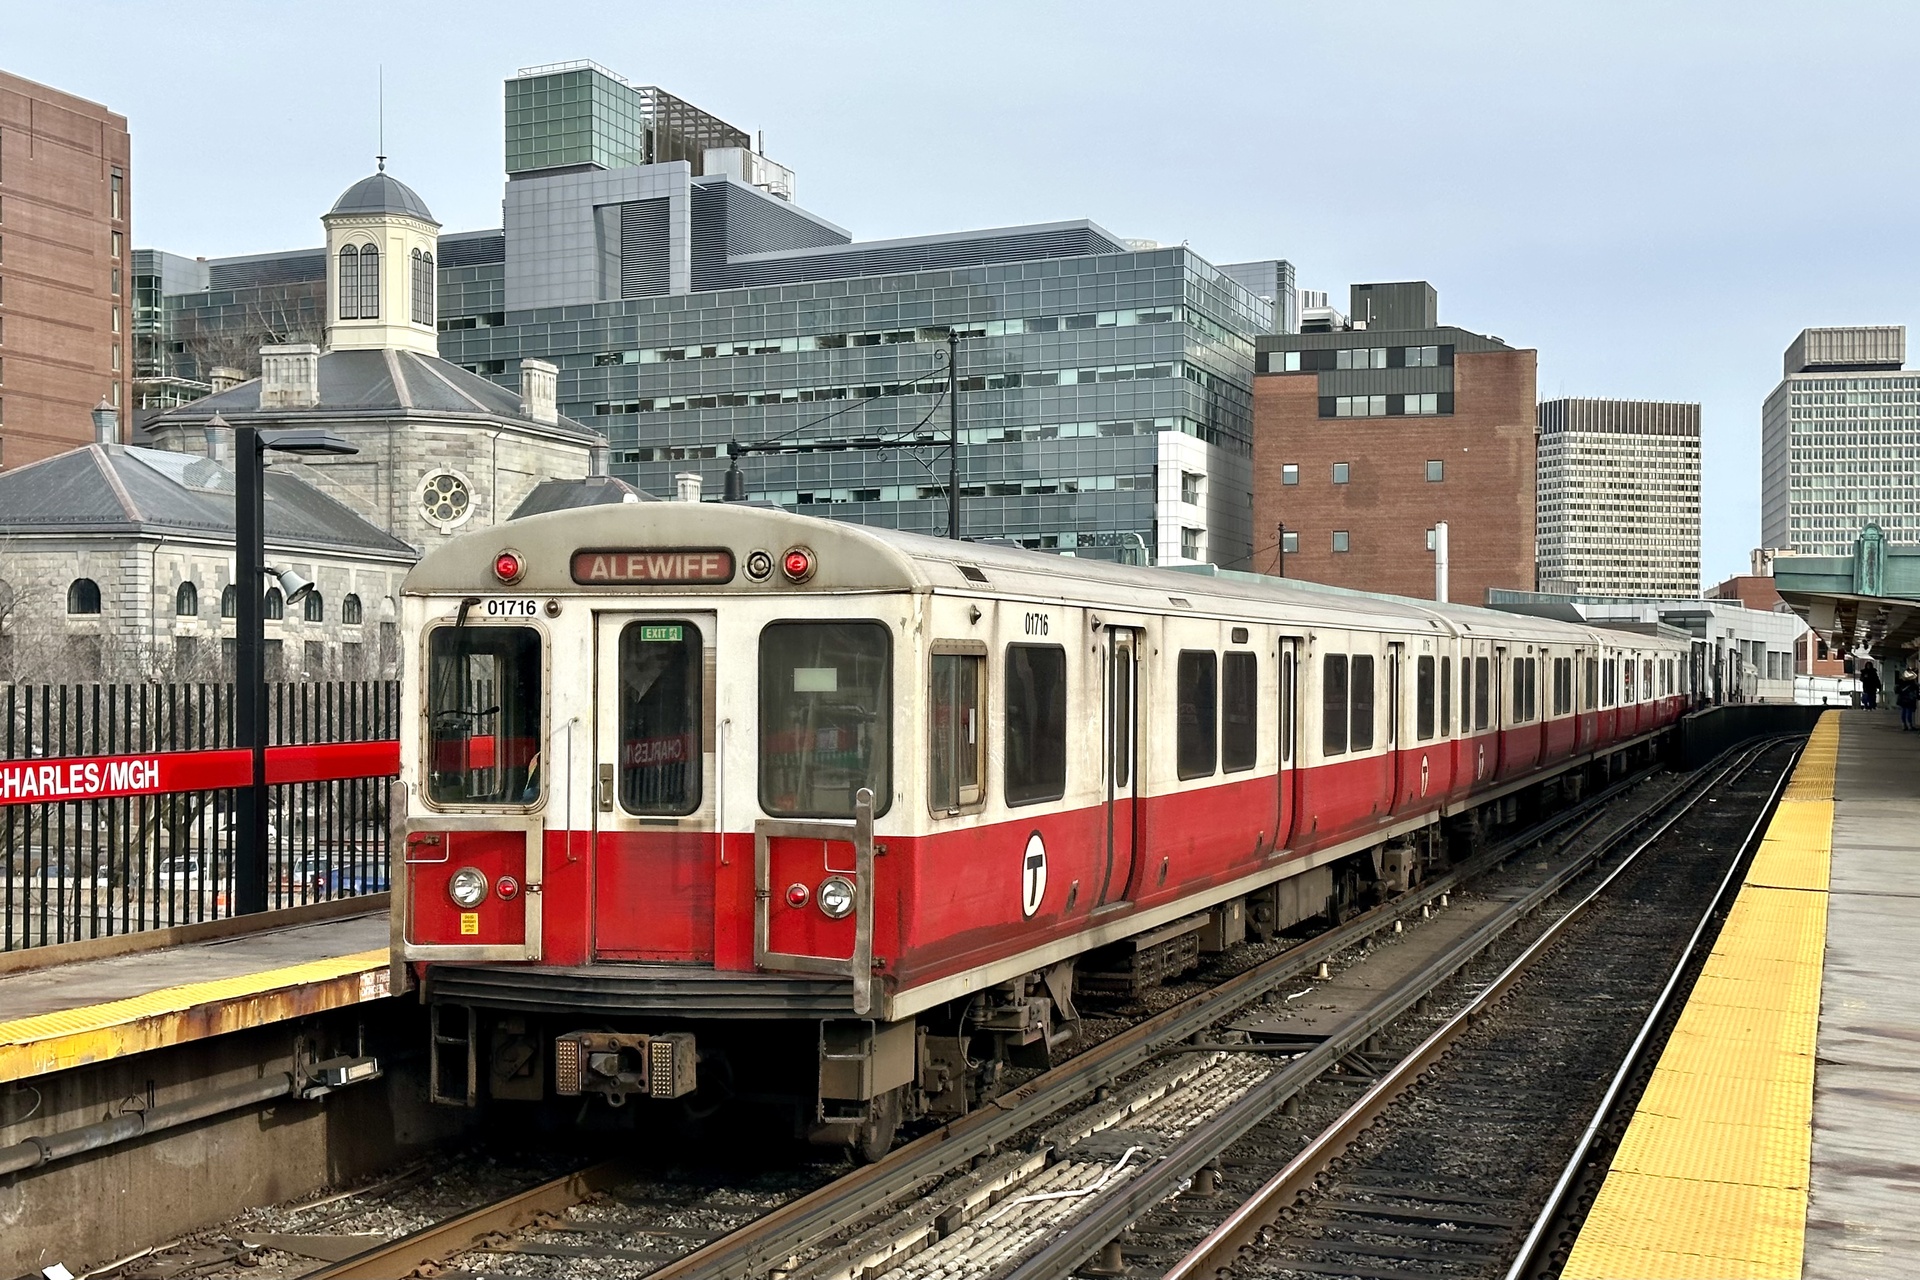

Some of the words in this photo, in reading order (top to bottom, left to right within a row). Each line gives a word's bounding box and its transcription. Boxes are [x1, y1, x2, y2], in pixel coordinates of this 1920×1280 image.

[590, 555, 720, 580] ALEWIFE
[488, 600, 536, 615] 01716
[646, 628, 667, 639] EXIT
[1025, 612, 1049, 636] 01716
[0, 759, 159, 799] HARLES/MGH
[1027, 854, 1043, 907] T
